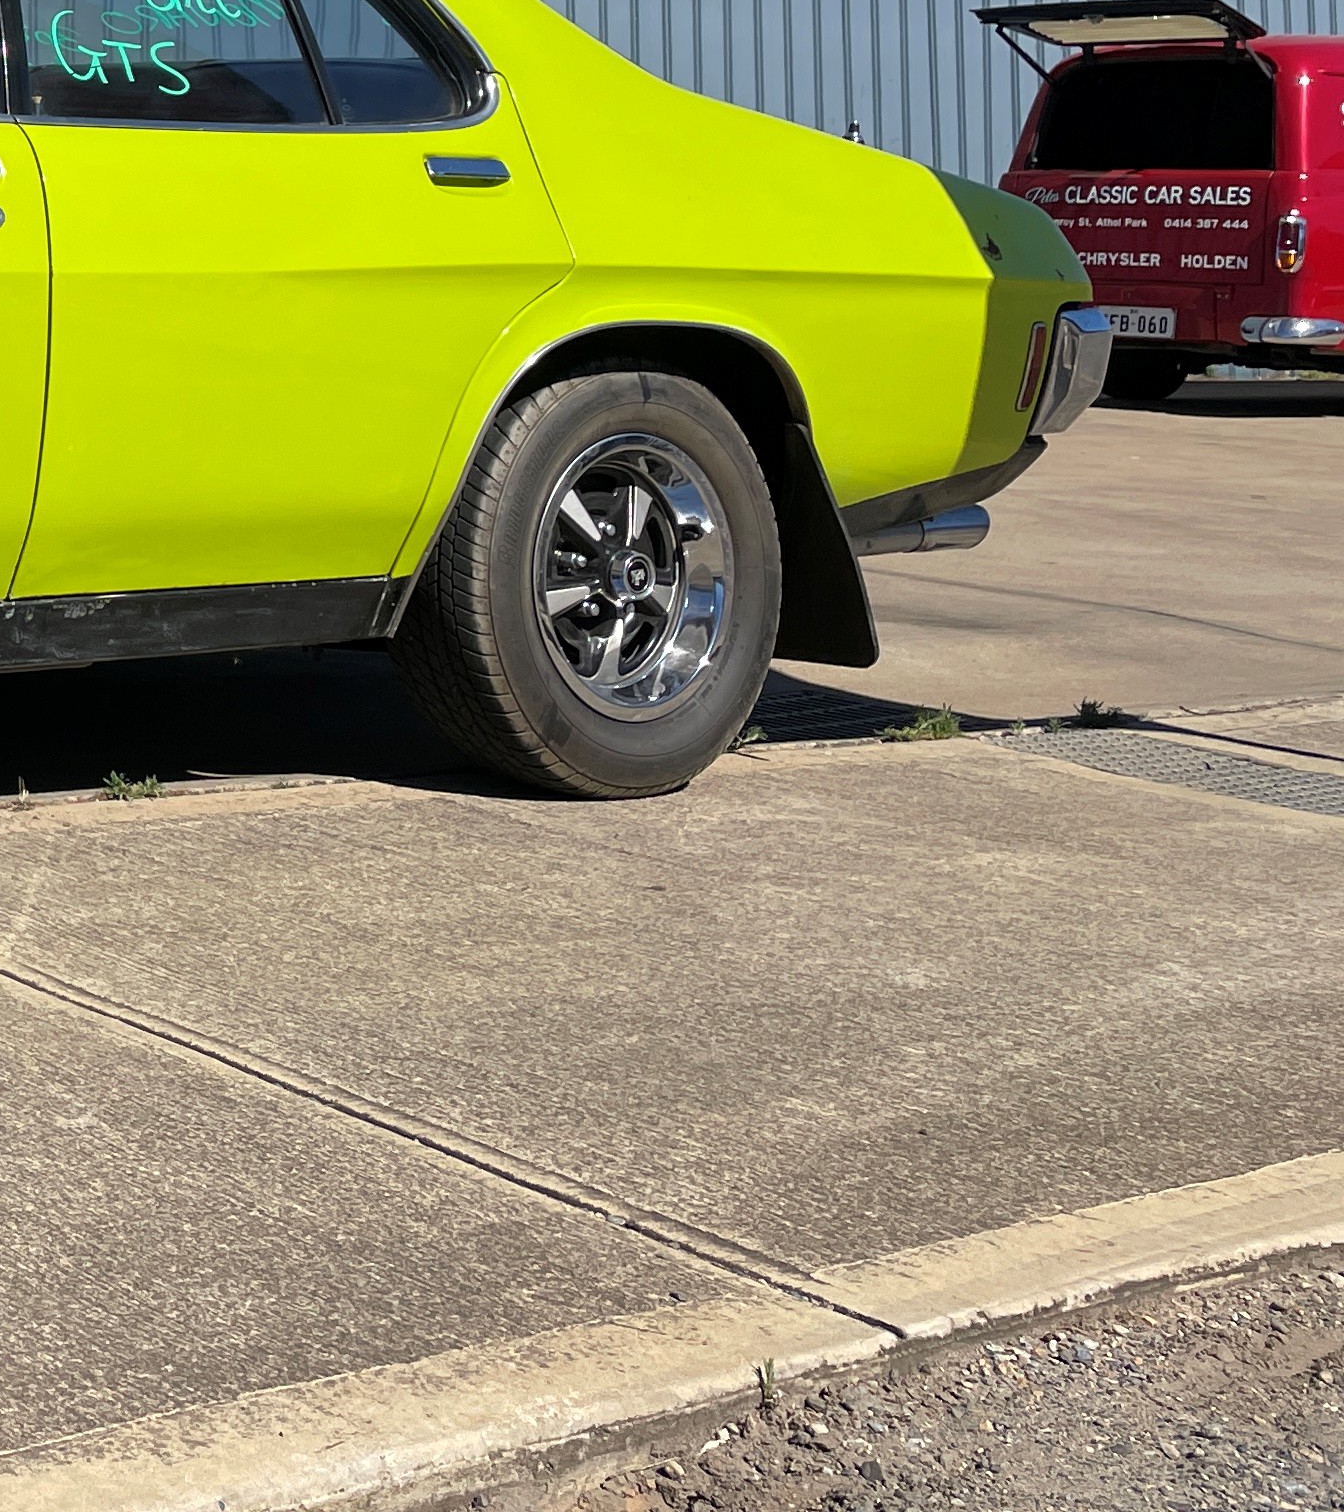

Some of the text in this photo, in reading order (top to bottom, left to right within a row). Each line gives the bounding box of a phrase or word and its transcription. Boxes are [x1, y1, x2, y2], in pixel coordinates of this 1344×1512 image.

[50, 9, 191, 95] GTS
[1064, 185, 1138, 204] CLASSIC
[1144, 186, 1183, 205] CAR
[1188, 186, 1251, 206] SALES
[1095, 217, 1121, 227] Athol
[1124, 217, 1148, 227] Park
[1164, 218, 1192, 228] 0414
[1196, 219, 1219, 229] 387
[1222, 219, 1249, 230] 444
[1078, 252, 1249, 270] CHRYSLER HOLDEN
